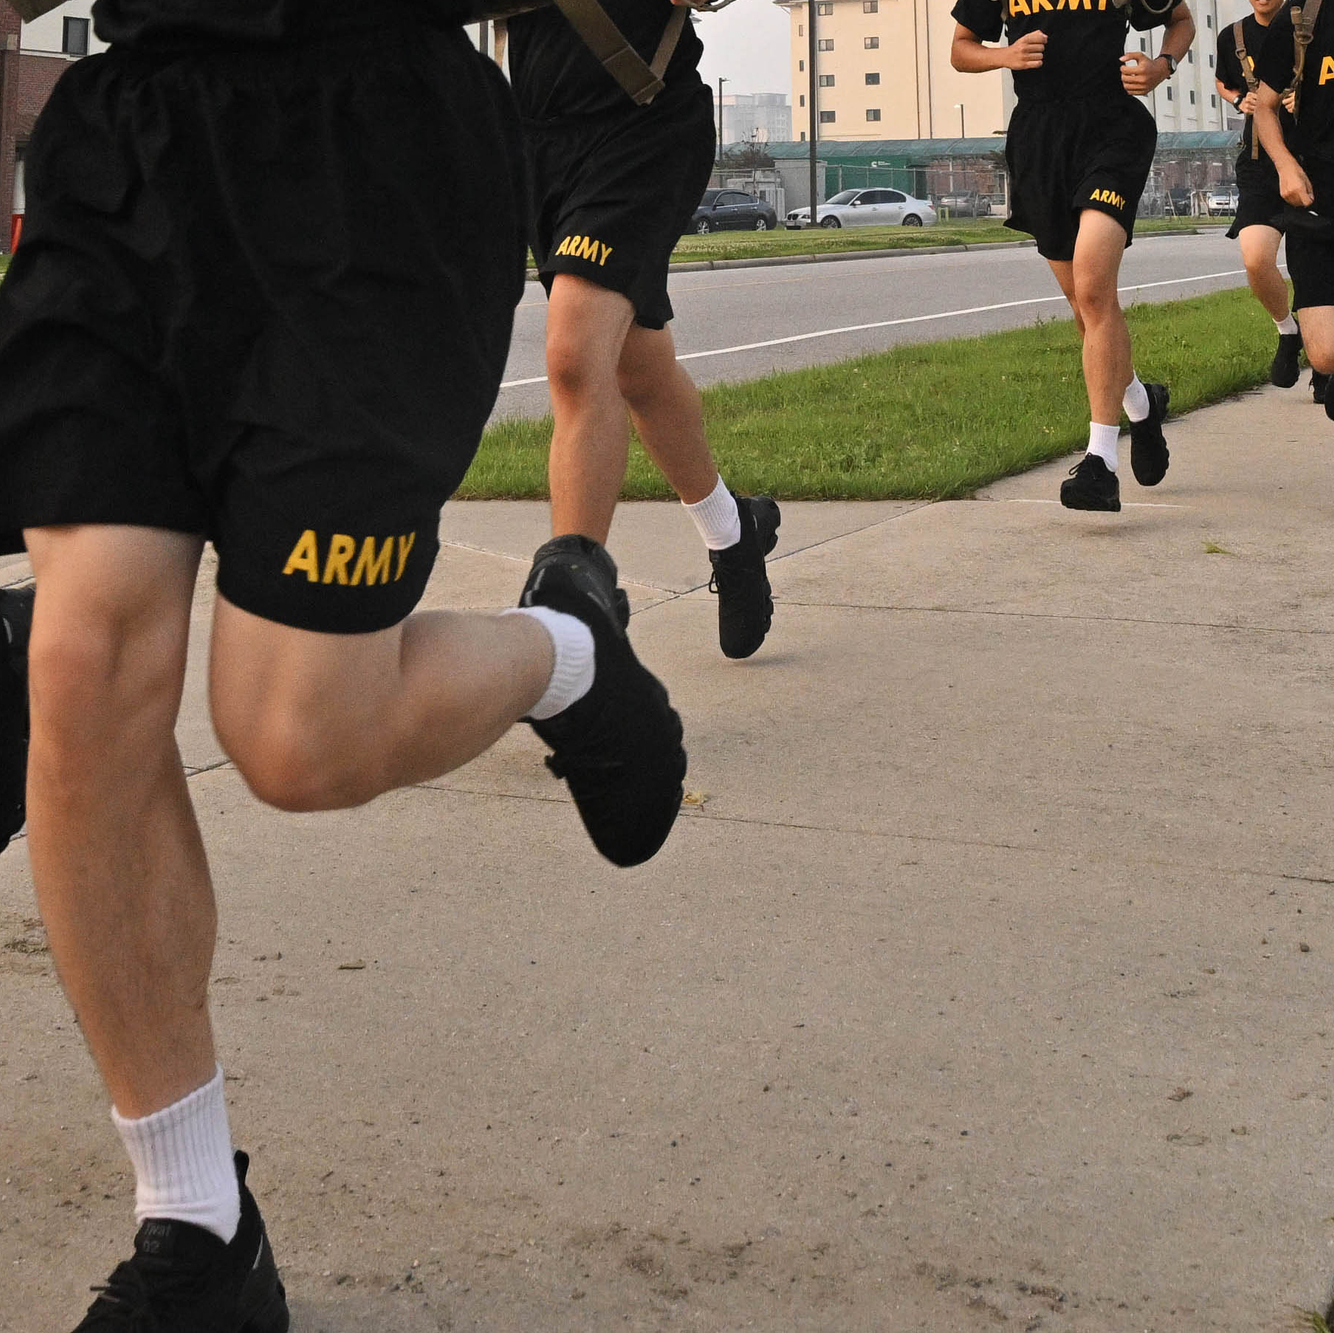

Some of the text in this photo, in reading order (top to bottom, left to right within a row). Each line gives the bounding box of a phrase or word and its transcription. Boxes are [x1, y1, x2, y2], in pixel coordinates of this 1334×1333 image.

[1089, 188, 1126, 210] ARMY
[555, 235, 613, 266] ARMY
[281, 529, 416, 586] ARMY
